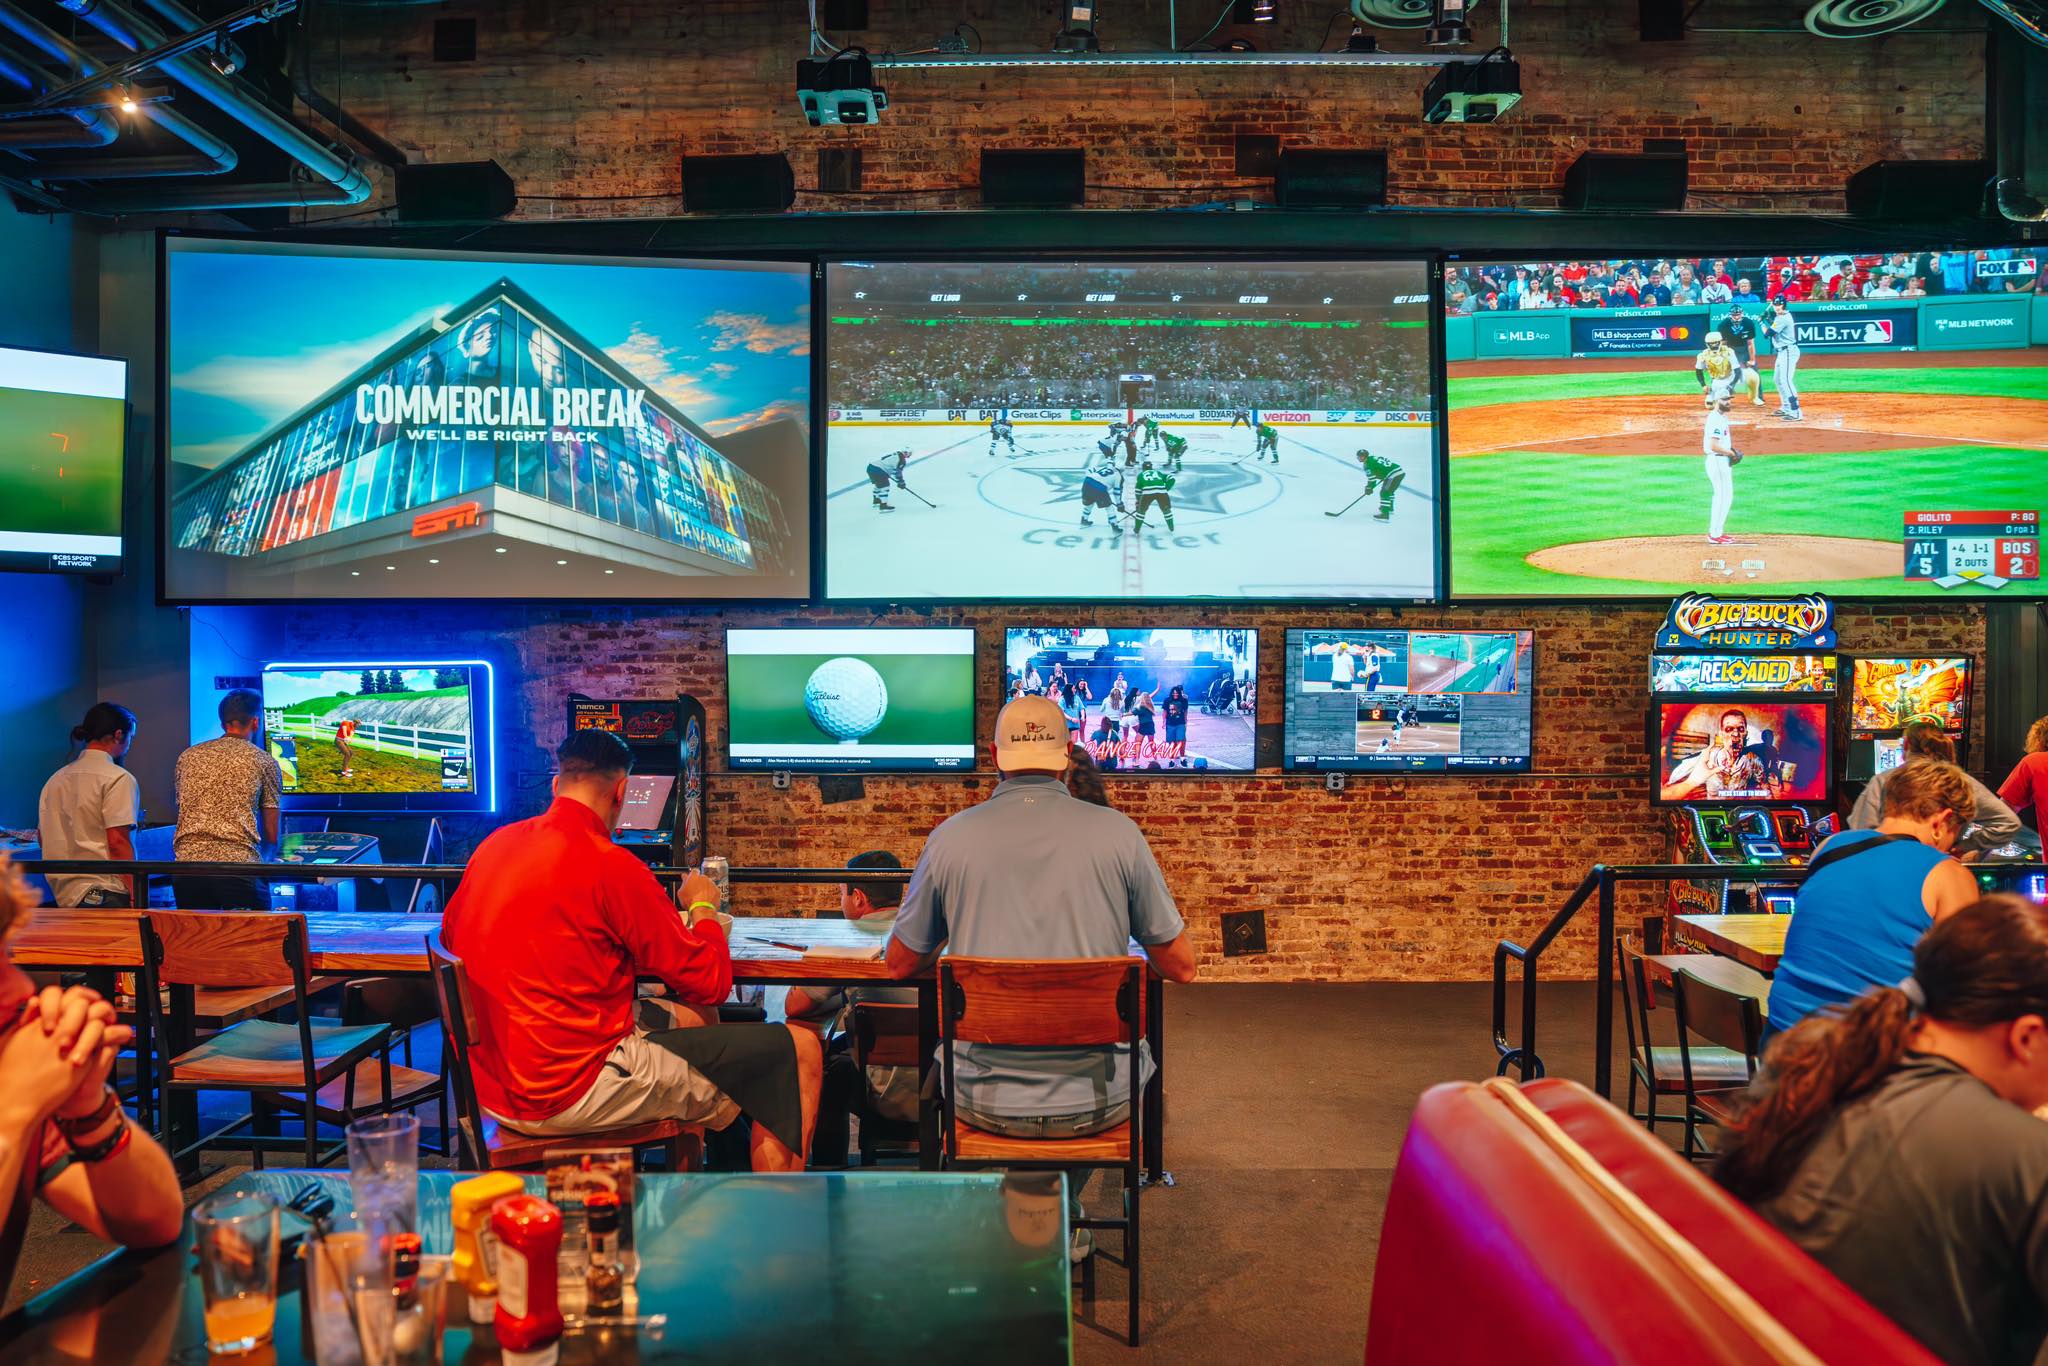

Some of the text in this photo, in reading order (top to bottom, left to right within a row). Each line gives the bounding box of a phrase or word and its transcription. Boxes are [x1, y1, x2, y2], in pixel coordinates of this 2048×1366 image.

[1979, 262, 2007, 275] FOX
[931, 294, 961, 302] GET LOUD
[1086, 294, 1116, 302] GET LOUD
[1239, 296, 1268, 304] GET LOUD
[1394, 296, 1408, 304] GET
[1818, 302, 1868, 311] redsox.com
[1615, 310, 1662, 318] redsox.com
[1948, 320, 1967, 329] MLB
[1968, 318, 2014, 328] NETWORK
[1509, 331, 1535, 341] MLB
[1798, 327, 1861, 341] MLB.TV
[356, 384, 646, 427] COMMERCIAL BREAK
[948, 410, 967, 421] CAT
[979, 410, 999, 421] CAT
[1011, 410, 1062, 420] Great Clips
[1150, 412, 1195, 420] MassMutual
[1264, 410, 1311, 422] verizon
[1327, 412, 1346, 422] SAP
[1355, 412, 1373, 422] SAP
[406, 429, 599, 443] WE'LL BE RIGHT BACK
[1917, 513, 1952, 522] GIOLITO
[2011, 513, 2020, 521] P:
[1918, 526, 1944, 534] RILEY
[1912, 542, 1939, 555] ATL
[1973, 543, 1990, 553] 1-1
[2002, 542, 2031, 554] BOS
[1955, 558, 1962, 567] 2
[1965, 559, 1988, 567] OUTS
[2010, 557, 2024, 575] 2
[1696, 603, 1811, 630] BIG BUCK
[1709, 632, 1793, 645] HUNTER
[1701, 659, 1790, 685] RELOADED
[1869, 663, 1907, 683] GODZILLA
[812, 691, 841, 701] Titleist
[1084, 740, 1183, 760] DANCE CAM
